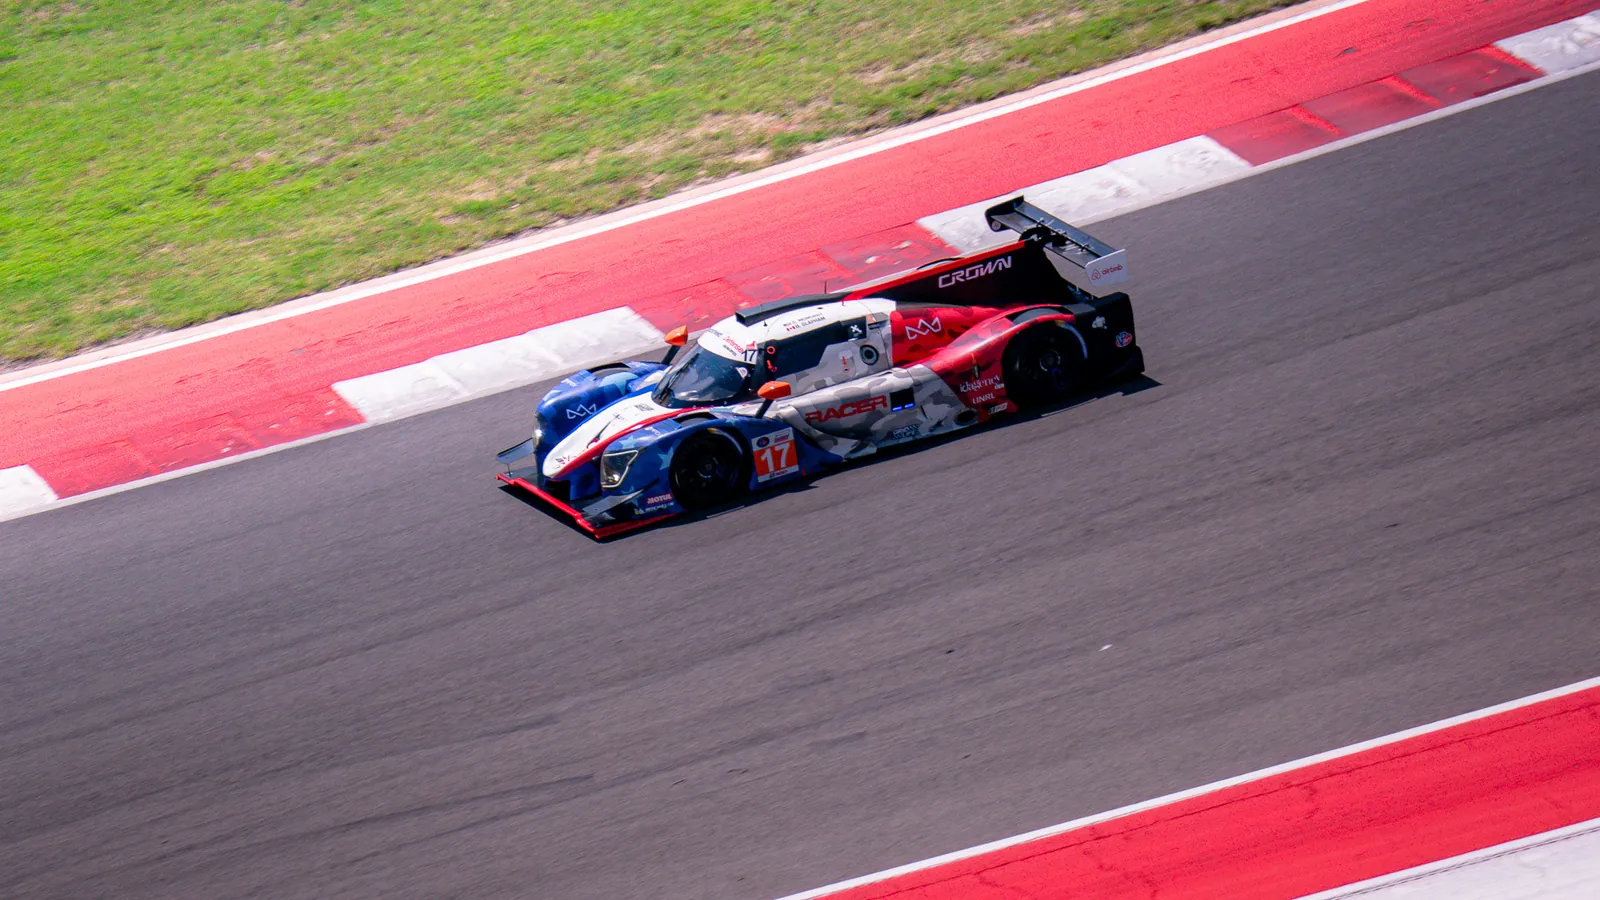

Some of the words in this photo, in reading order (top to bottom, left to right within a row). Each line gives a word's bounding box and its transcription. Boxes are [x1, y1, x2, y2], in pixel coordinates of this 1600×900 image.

[938, 255, 1012, 289] CROWN
[1101, 264, 1123, 276] airbnb
[741, 348, 758, 362] 17
[972, 392, 996, 405] UNRL
[805, 395, 888, 425] RACER
[760, 442, 790, 472] 17
[647, 494, 672, 505] MOTUL
